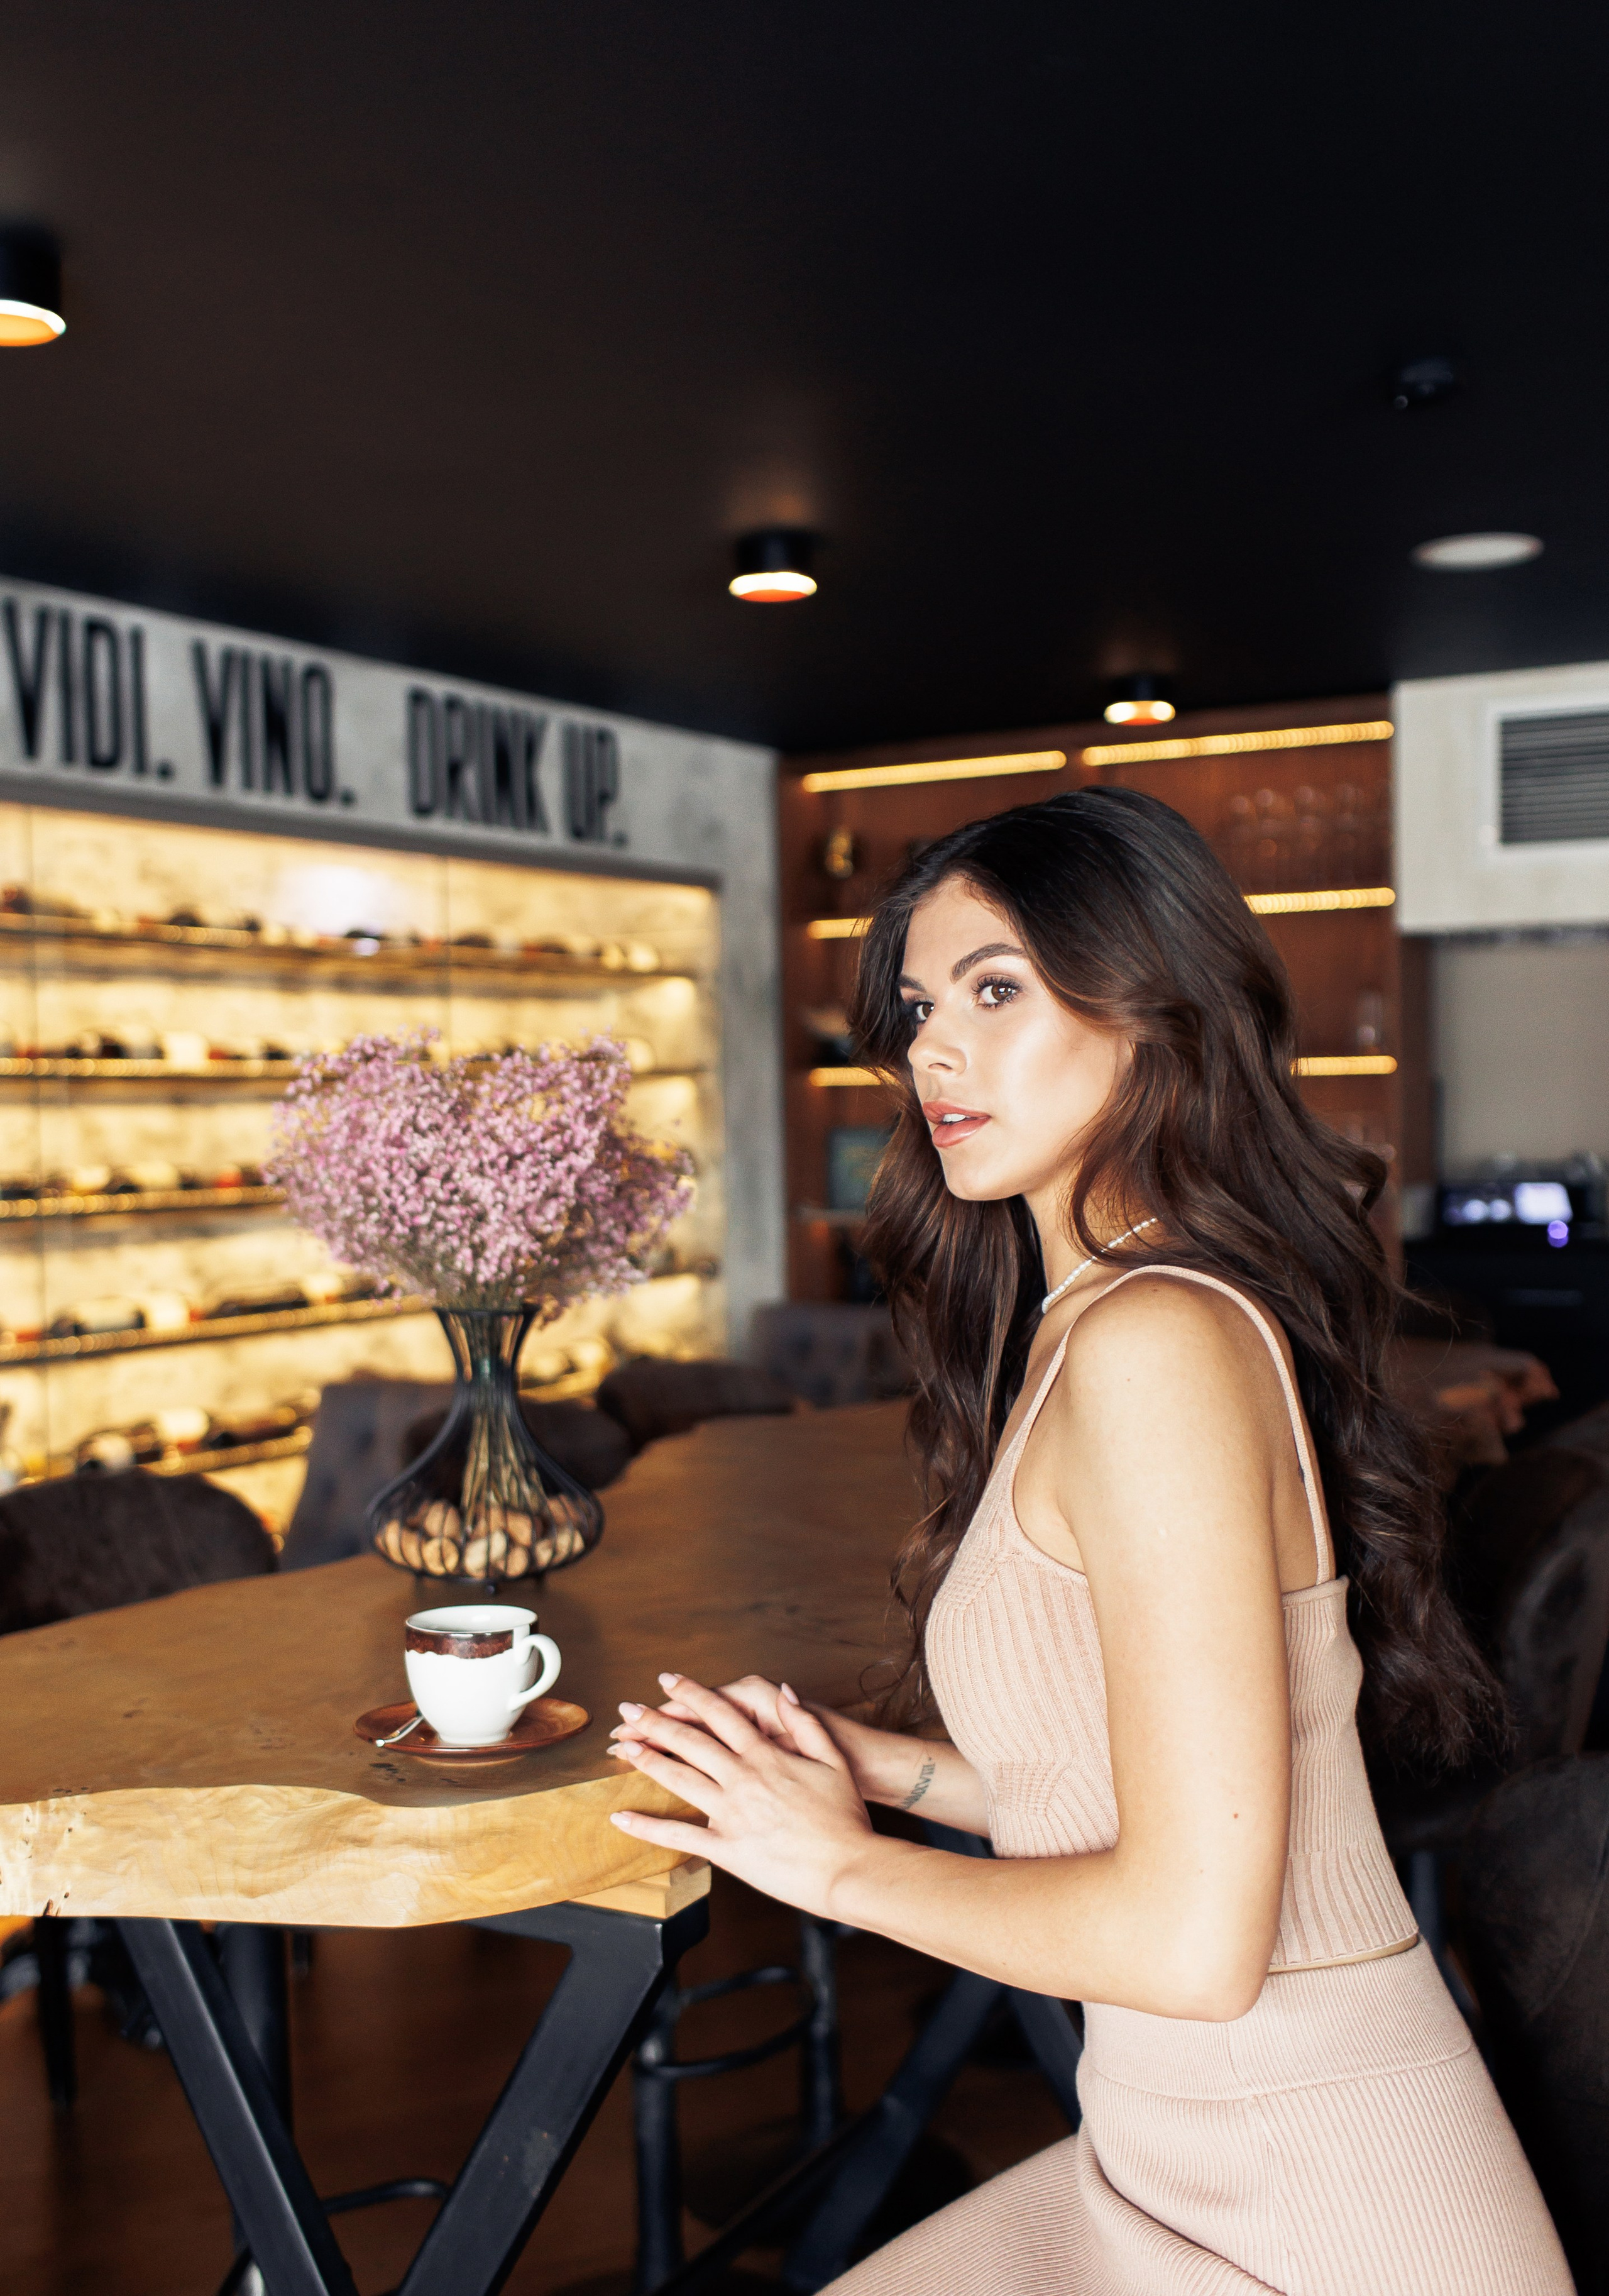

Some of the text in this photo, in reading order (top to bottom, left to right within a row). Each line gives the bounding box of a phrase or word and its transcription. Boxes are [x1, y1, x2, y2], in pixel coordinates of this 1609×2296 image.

[2, 599, 628, 849] VIDI. VINO. DRINK UP.
